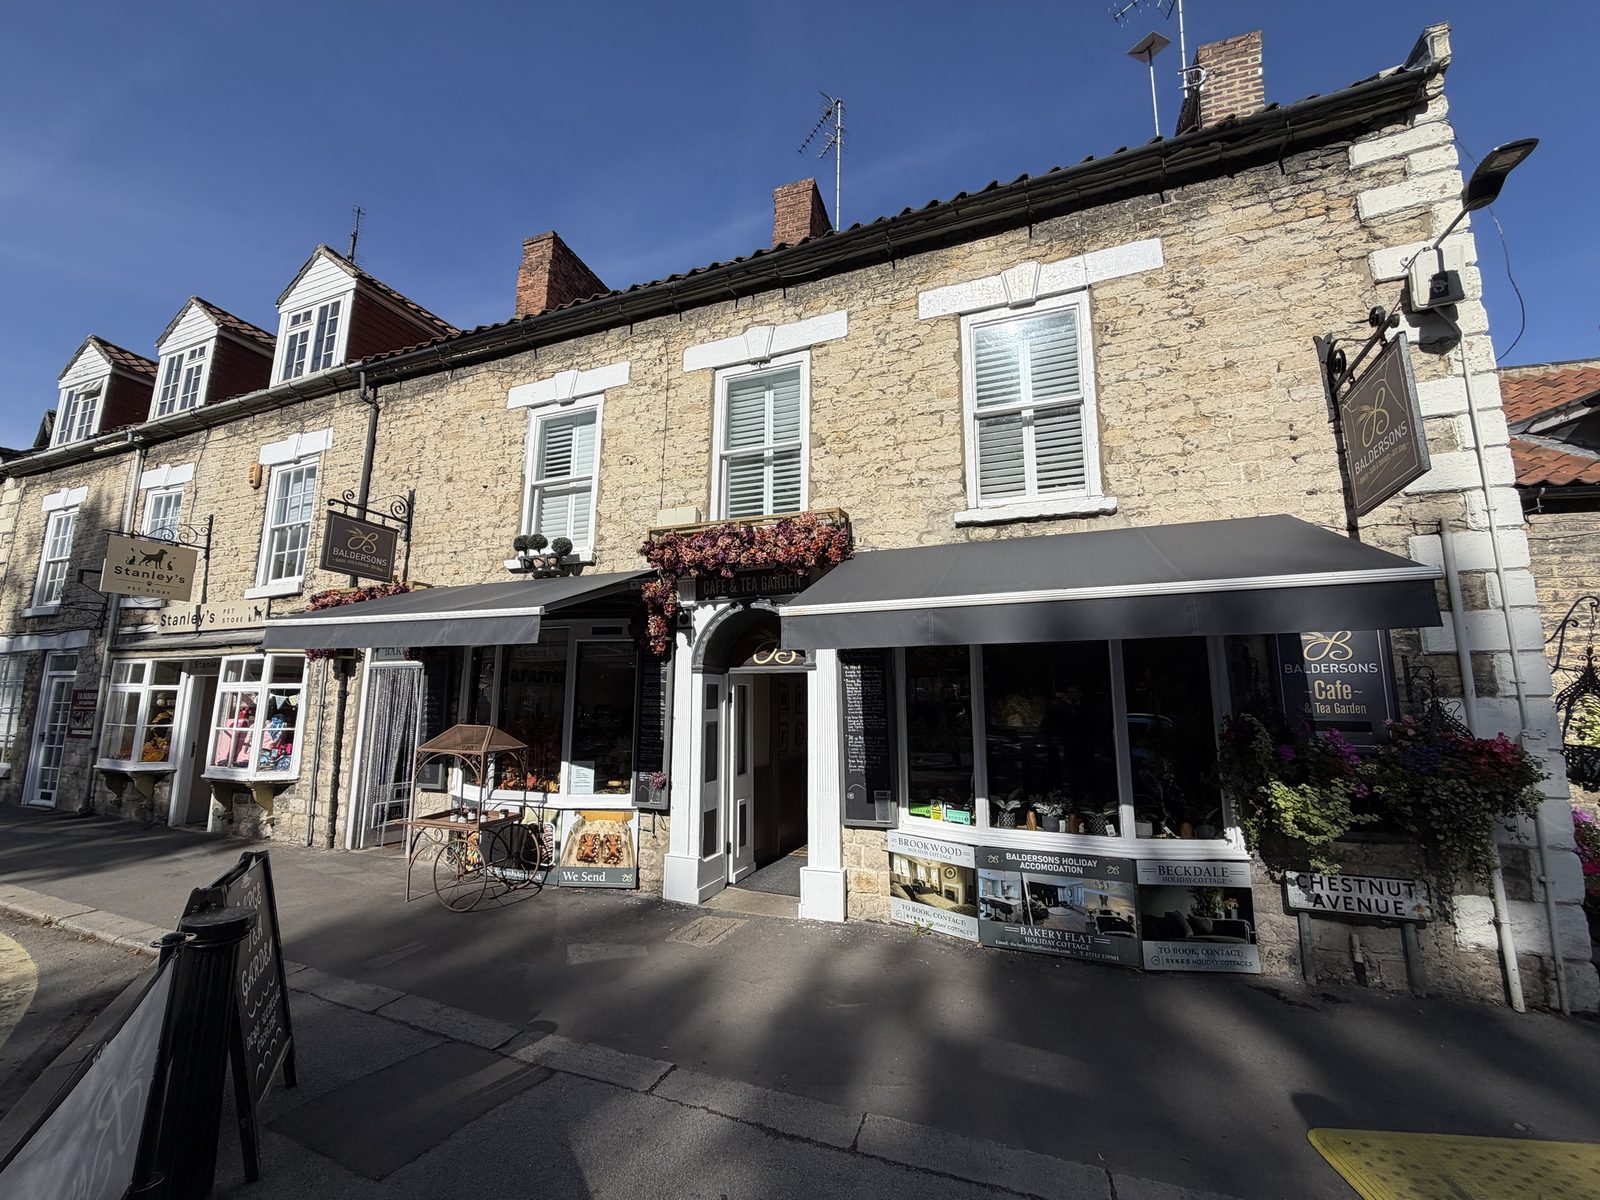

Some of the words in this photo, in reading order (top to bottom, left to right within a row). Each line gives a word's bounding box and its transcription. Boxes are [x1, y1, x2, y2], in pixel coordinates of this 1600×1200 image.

[1354, 420, 1408, 475] BALDERSONS
[333, 547, 387, 566] BALDERSONS
[114, 565, 185, 584] Stanley's
[703, 579, 726, 595] CAFE
[729, 577, 737, 593] &
[741, 576, 758, 592] TEA
[761, 573, 801, 590] GARDEN
[160, 609, 215, 628] Stanley's
[222, 616, 243, 624] STORE
[1284, 662, 1378, 674] BALDERSONS
[1304, 703, 1312, 714] &
[1314, 702, 1331, 714] Tea
[1334, 702, 1367, 714] Garden
[898, 837, 962, 857] BROOKWOOD
[908, 847, 928, 856] HOLIDAY
[929, 850, 952, 860] COTTAGE
[1006, 852, 1060, 864] BALDERSONS
[1062, 857, 1098, 867] HOLIDAY
[1020, 861, 1083, 874] ACCOMODATION
[562, 871, 578, 881] We
[581, 872, 606, 882] Send
[1158, 865, 1229, 878] BECKDALE
[1296, 874, 1416, 899] CHESTNUT
[1313, 893, 1406, 916] AVENUE
[901, 903, 911, 912] TO
[912, 905, 932, 917] BOOK,
[933, 910, 967, 926] CONTACT:
[906, 913, 925, 923] SYKES
[947, 924, 974, 936] COTTAGES
[1020, 926, 1064, 940] BAKERY
[1066, 932, 1094, 944] FLAT
[1025, 936, 1055, 946] HOLIDAY
[1056, 940, 1091, 951] COTTAGE
[1173, 947, 1199, 955] BOOK,
[1201, 948, 1243, 957] CONTACT:
